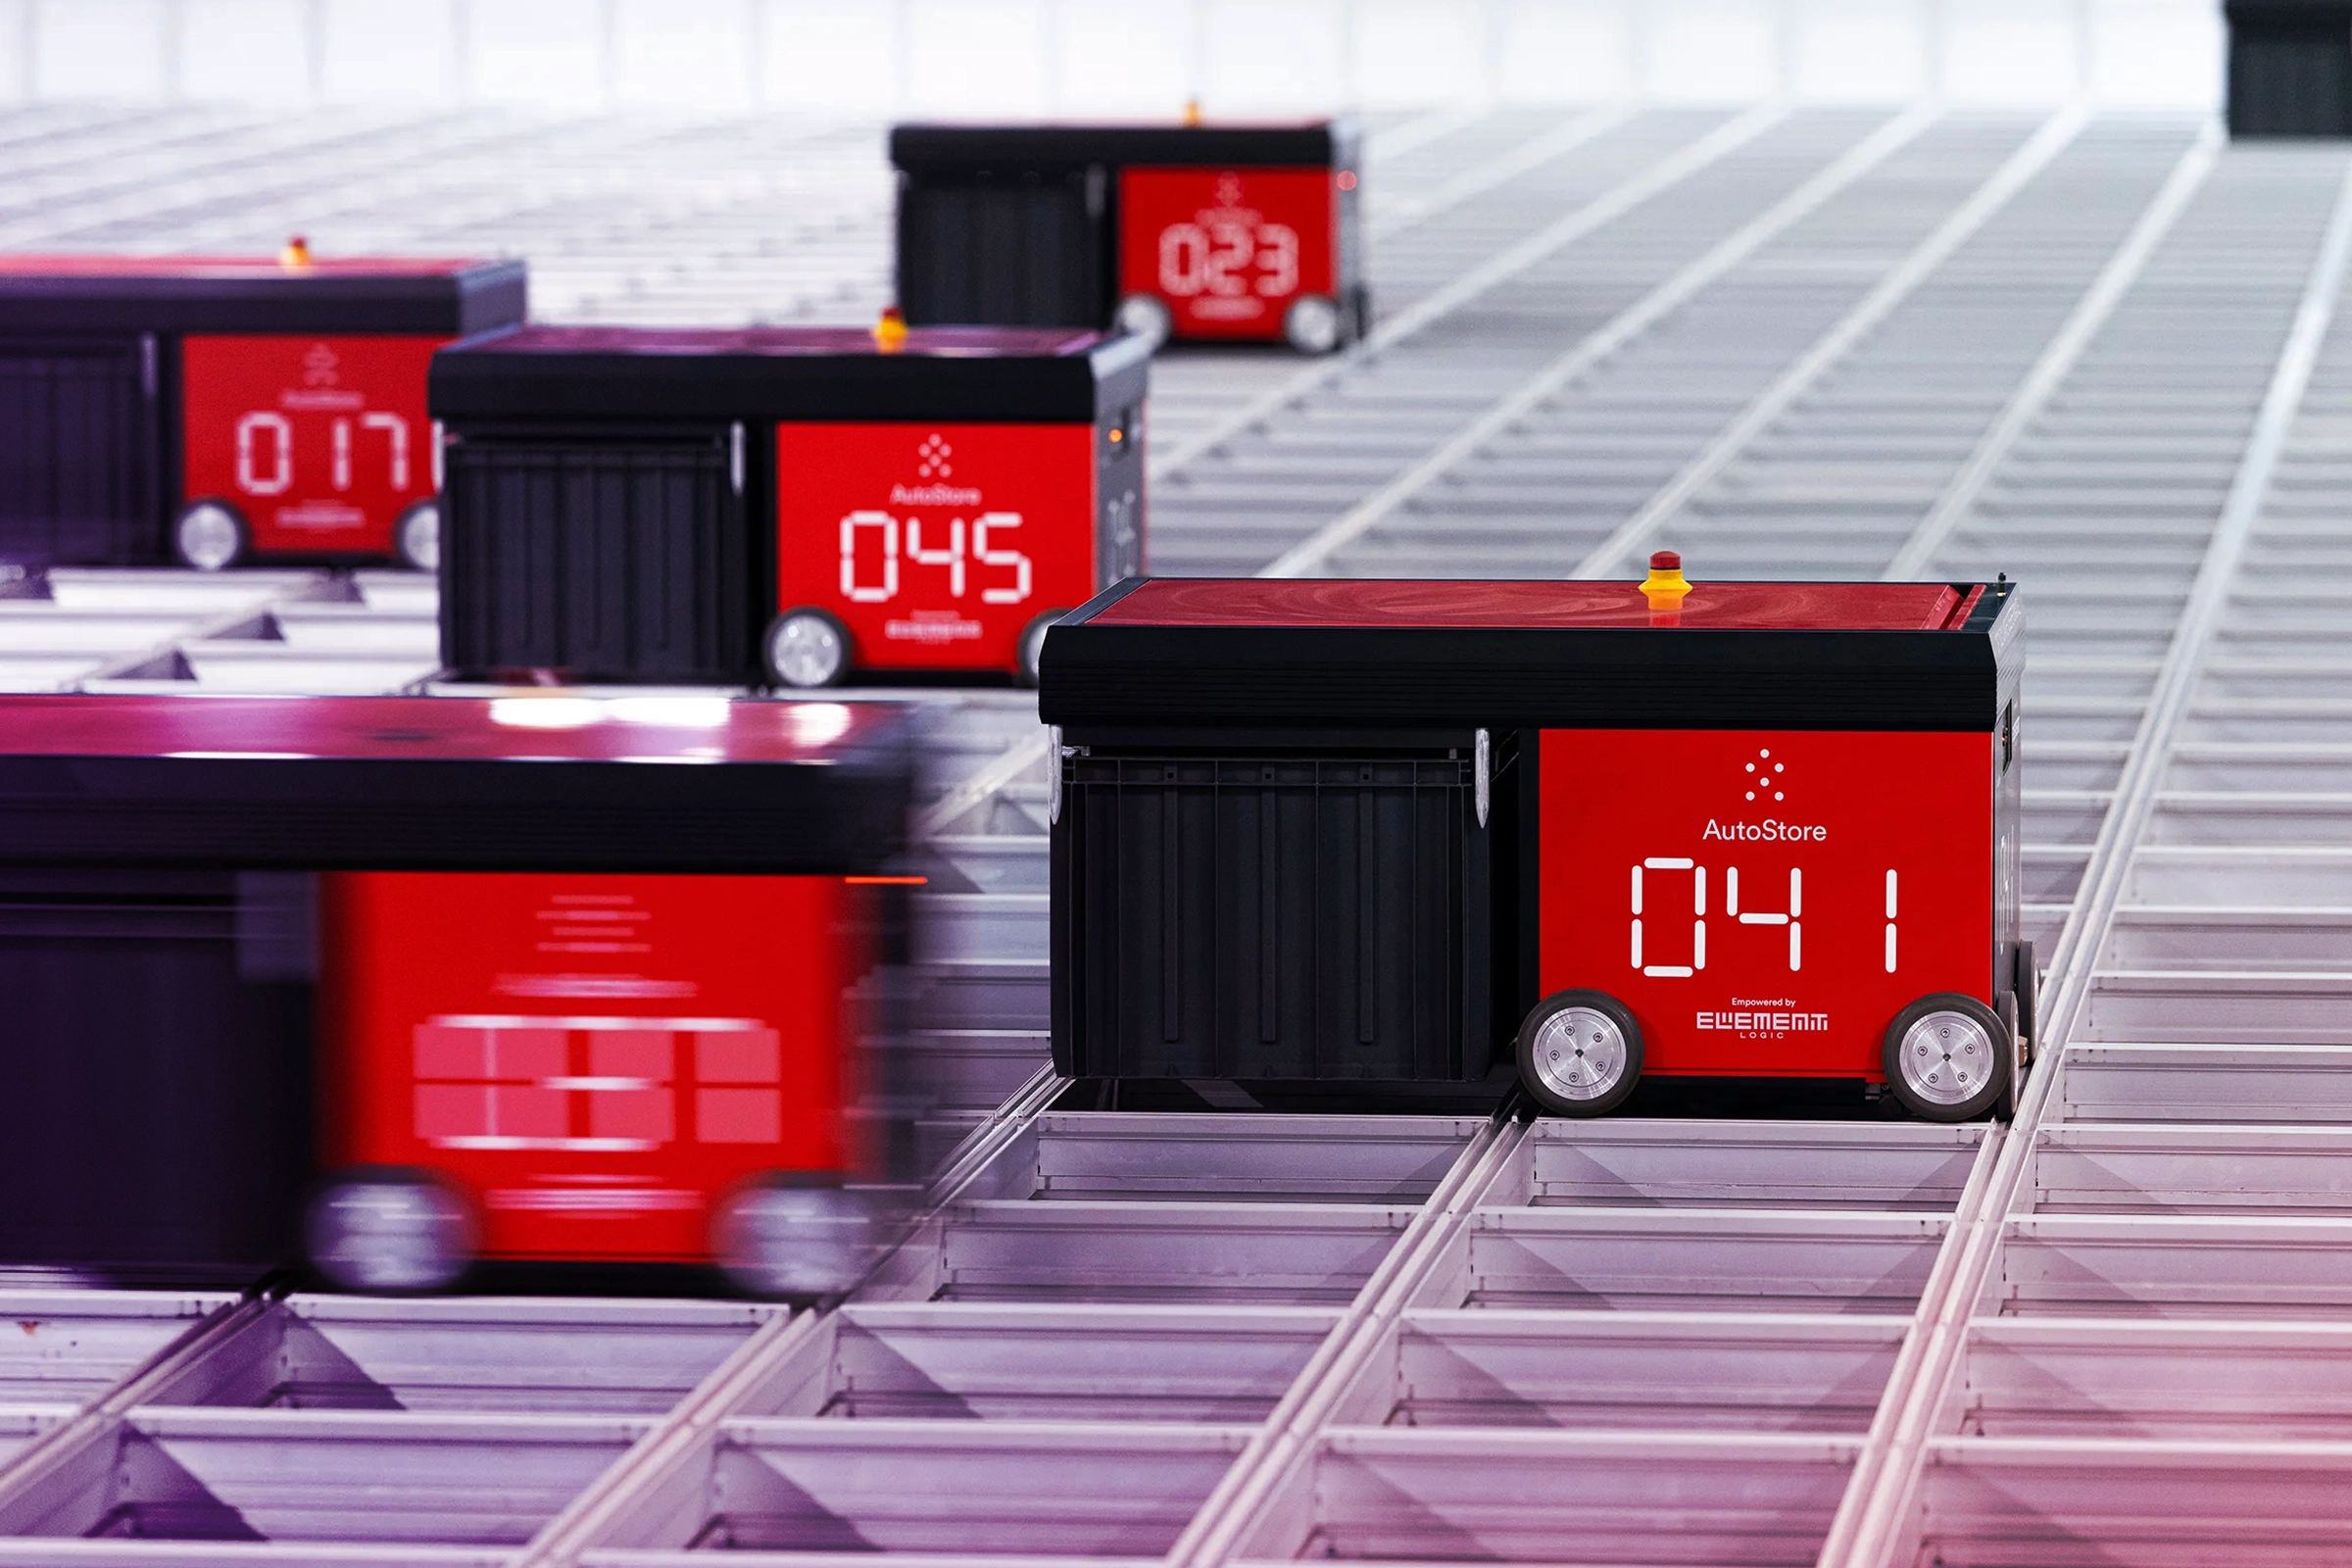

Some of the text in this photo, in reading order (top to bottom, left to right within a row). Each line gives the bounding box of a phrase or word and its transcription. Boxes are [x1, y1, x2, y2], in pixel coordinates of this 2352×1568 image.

[1158, 221, 1298, 297] 023
[238, 412, 408, 495] 017
[840, 510, 1032, 605] 045
[1702, 818, 1828, 841] AutoStore
[1731, 997, 1796, 1008] Empowered by
[1696, 1011, 1829, 1031] ELEMENT
[1740, 1031, 1785, 1040] LOGIC
